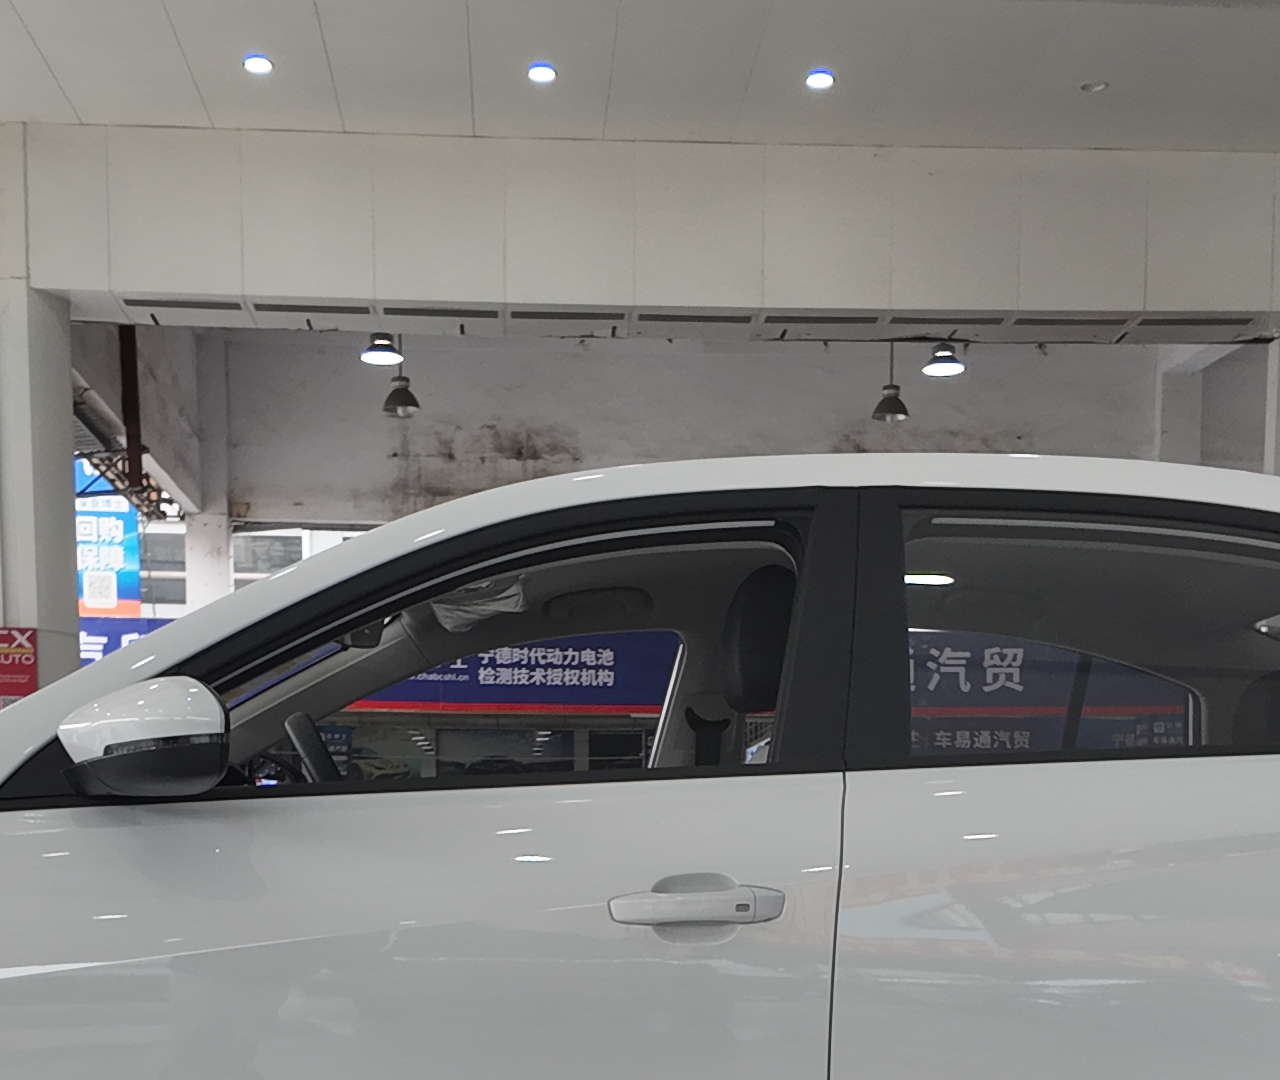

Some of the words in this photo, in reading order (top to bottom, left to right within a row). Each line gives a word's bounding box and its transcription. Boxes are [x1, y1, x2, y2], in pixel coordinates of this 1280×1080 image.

[478, 667, 614, 686] 检测技术授权机构
[910, 647, 1024, 692] 汽贸
[934, 730, 1031, 749] 车易通汽贸
